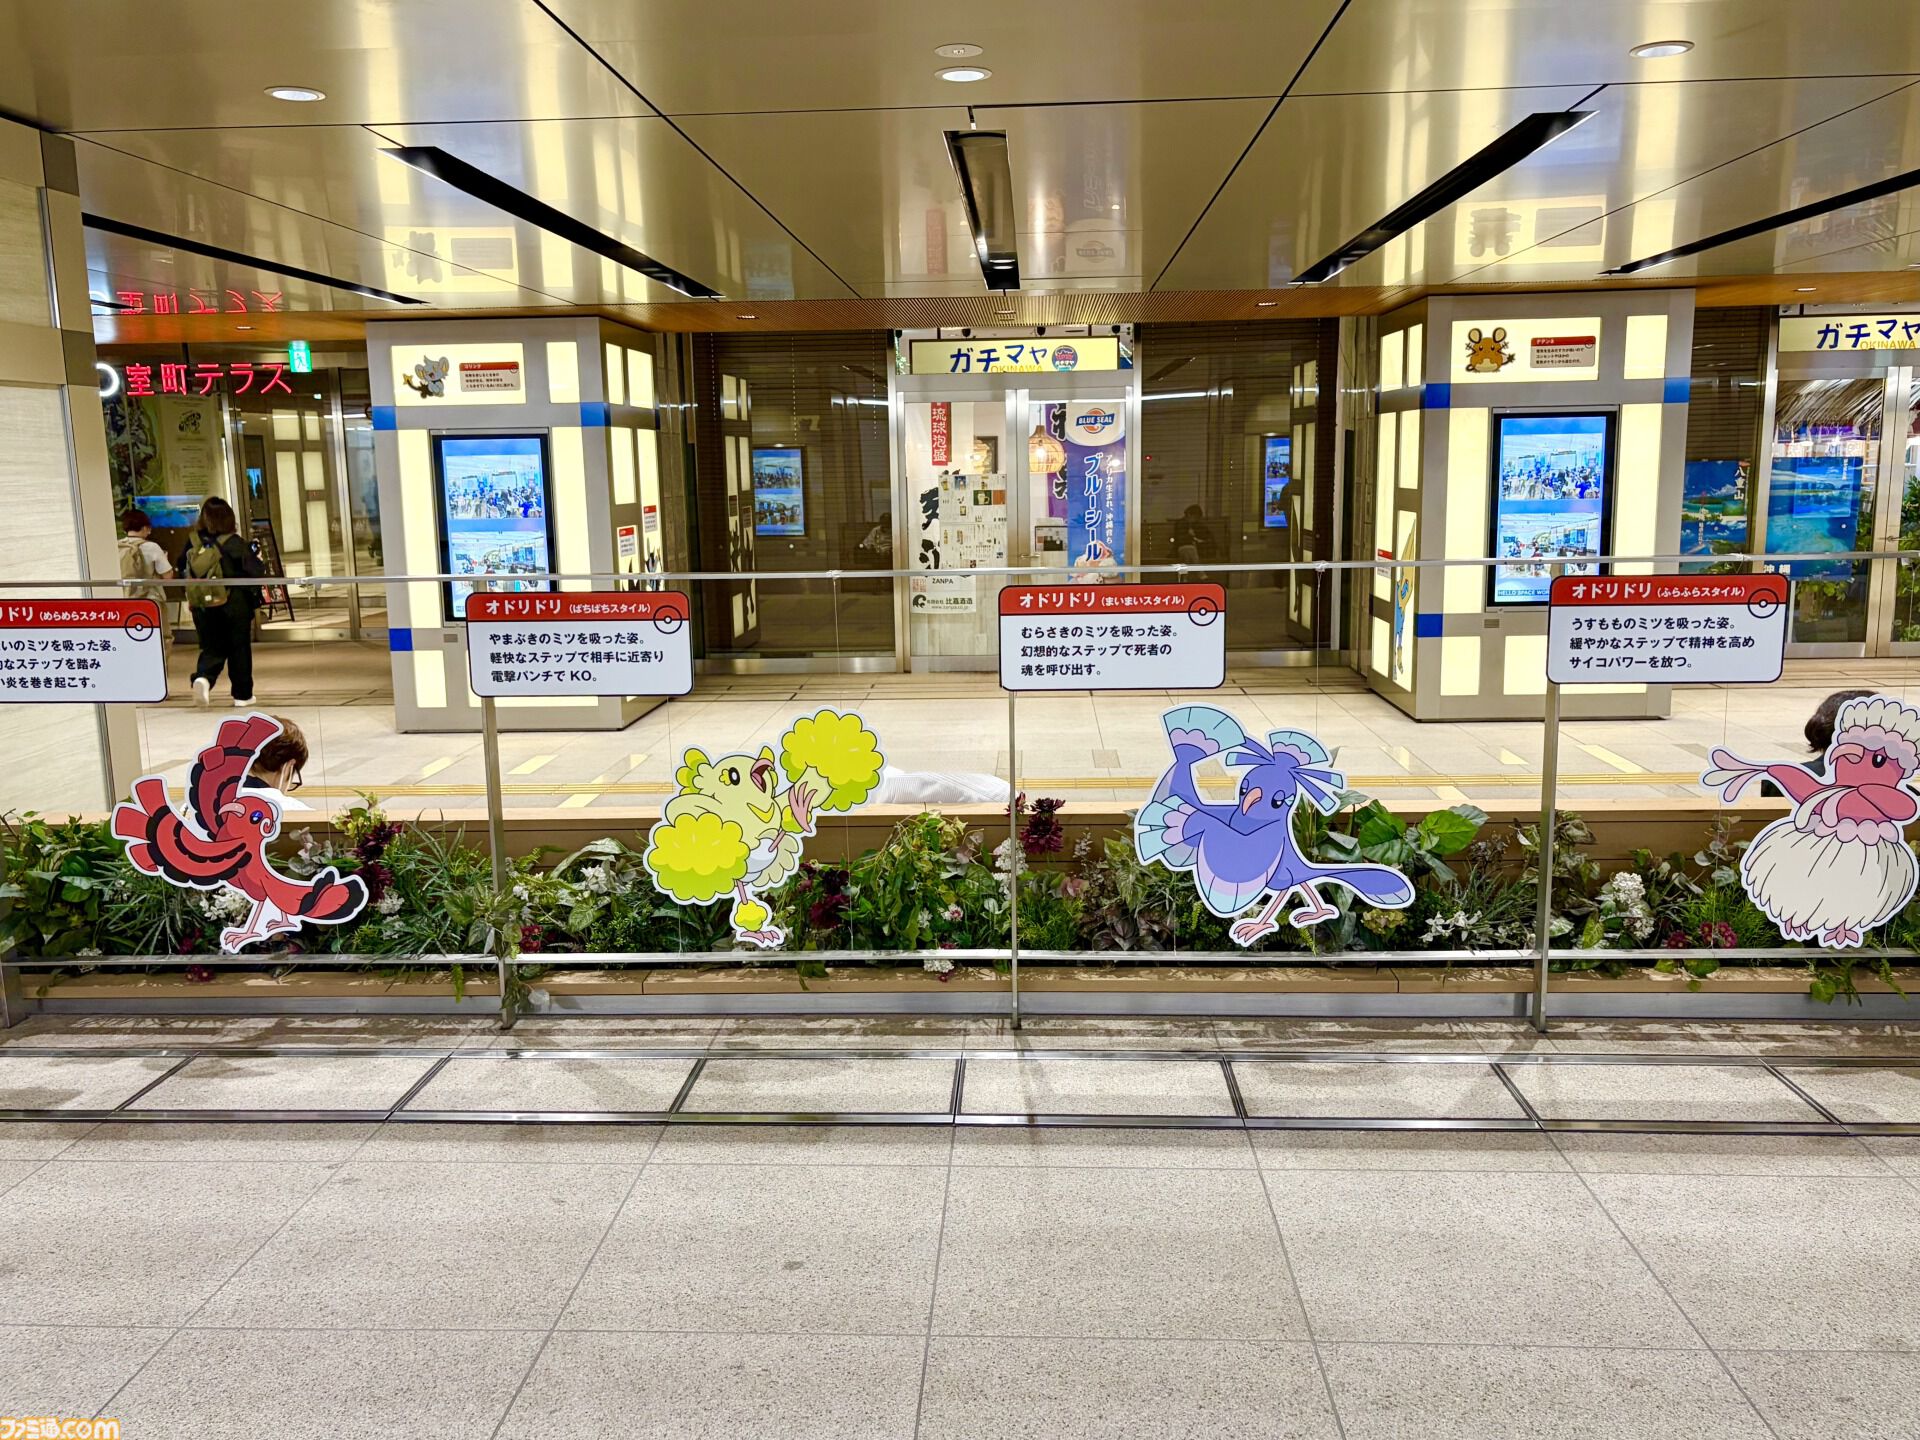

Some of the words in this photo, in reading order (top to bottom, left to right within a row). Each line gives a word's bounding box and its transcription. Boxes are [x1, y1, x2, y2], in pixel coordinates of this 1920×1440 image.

[1860, 341, 1916, 350] OKINAWA
[950, 344, 1048, 373] ガチマヤ
[991, 364, 1044, 374] OKINAWA
[126, 362, 292, 396] 室町テラス
[1078, 417, 1095, 425] BLUE
[1096, 415, 1113, 424] SEAL
[1084, 452, 1103, 562] ブルーシール
[1572, 583, 1652, 599] オドリドリ
[485, 599, 562, 615] オドリドリ
[1019, 592, 1096, 608] オドリドリ
[1572, 616, 1736, 631] うすもものミツを吸った姿。
[489, 632, 645, 646] やまぶきのミツを吸った姿。
[1021, 624, 1178, 639] むらさきのミツを吸った姿。
[1021, 643, 1172, 657] 幻想的なステップで死者の
[1569, 635, 1755, 650] 緩やかなステップで精神を高め
[490, 650, 665, 664] 軽快なステップで相手に近寄り
[1569, 655, 1693, 669] サイコパワーを放つ。
[1021, 663, 1102, 676] 魂を呼び出す。
